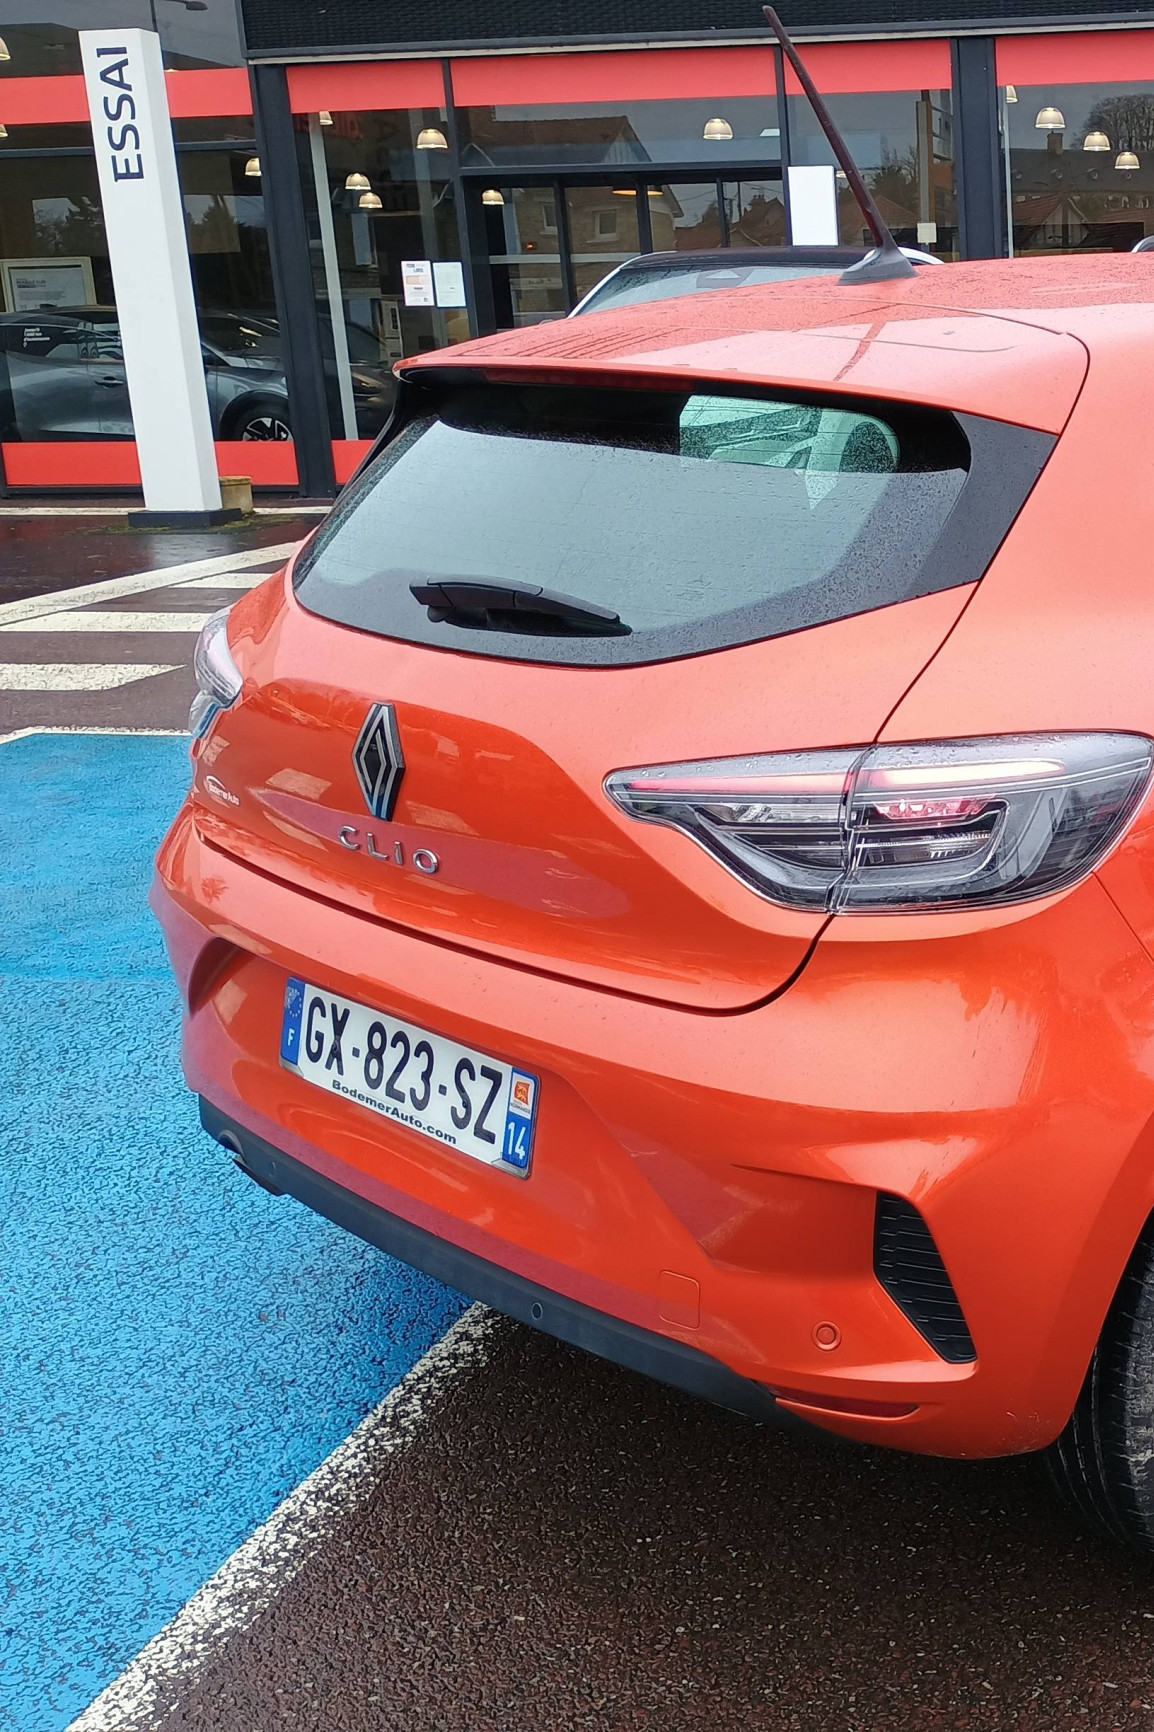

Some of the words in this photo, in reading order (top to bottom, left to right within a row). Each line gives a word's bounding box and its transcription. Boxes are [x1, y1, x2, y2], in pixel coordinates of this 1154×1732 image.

[96, 46, 144, 182] ESSAI
[338, 825, 439, 874] CLIO
[287, 1028, 295, 1047] F
[305, 996, 503, 1145] GX-823-SZ
[332, 1079, 457, 1145] BodemerAuto.com
[507, 1121, 526, 1160] 14
